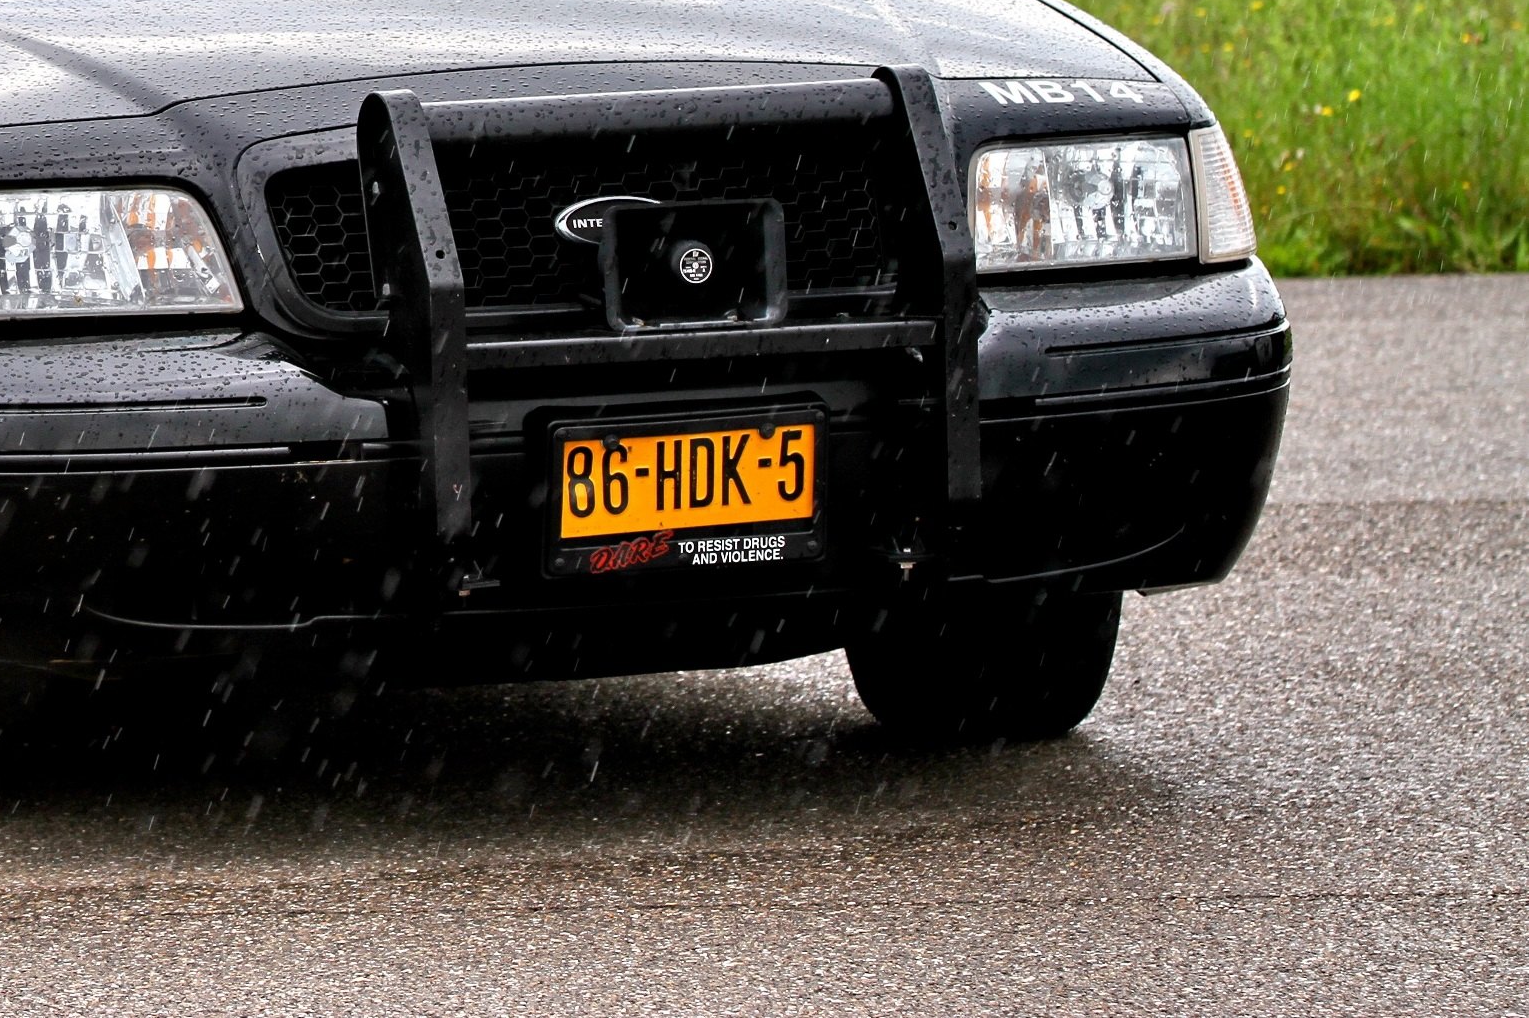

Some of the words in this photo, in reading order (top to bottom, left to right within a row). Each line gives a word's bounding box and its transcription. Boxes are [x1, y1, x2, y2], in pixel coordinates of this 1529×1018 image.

[977, 80, 1145, 105] MB14
[566, 429, 805, 519] 86-HDK-5
[677, 541, 695, 554] TO
[697, 538, 741, 553] RESIST
[743, 535, 786, 550] DRUGS
[692, 552, 718, 565] AND
[720, 548, 784, 563] VIOLENCE.
